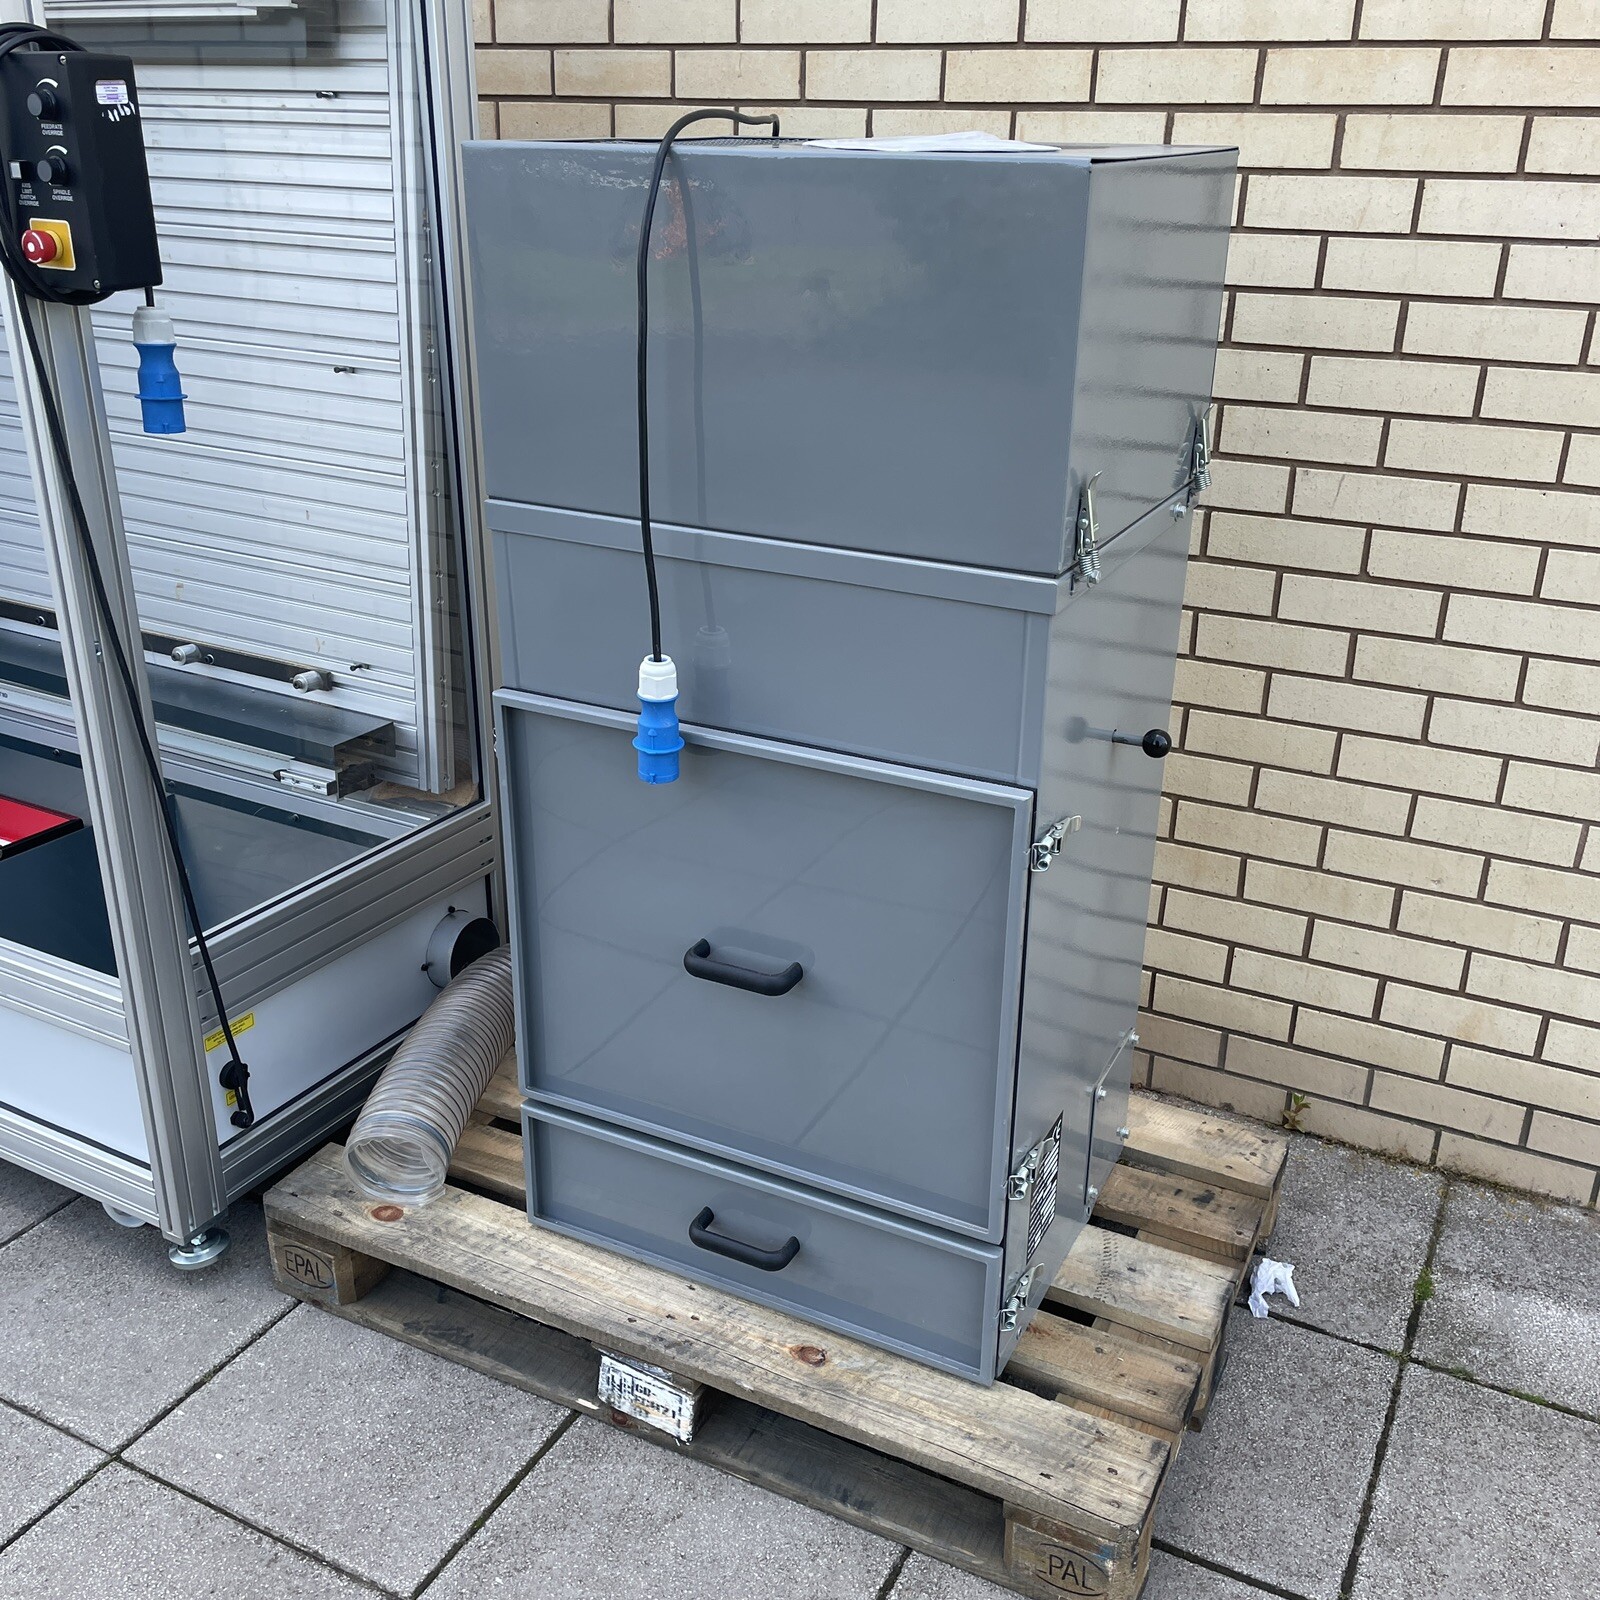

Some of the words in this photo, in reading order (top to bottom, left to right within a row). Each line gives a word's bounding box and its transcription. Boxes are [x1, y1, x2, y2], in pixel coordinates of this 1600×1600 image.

[51, 194, 74, 202] OVERRIDE
[284, 1249, 327, 1285] EPAL
[1037, 1553, 1095, 1592] PAL
